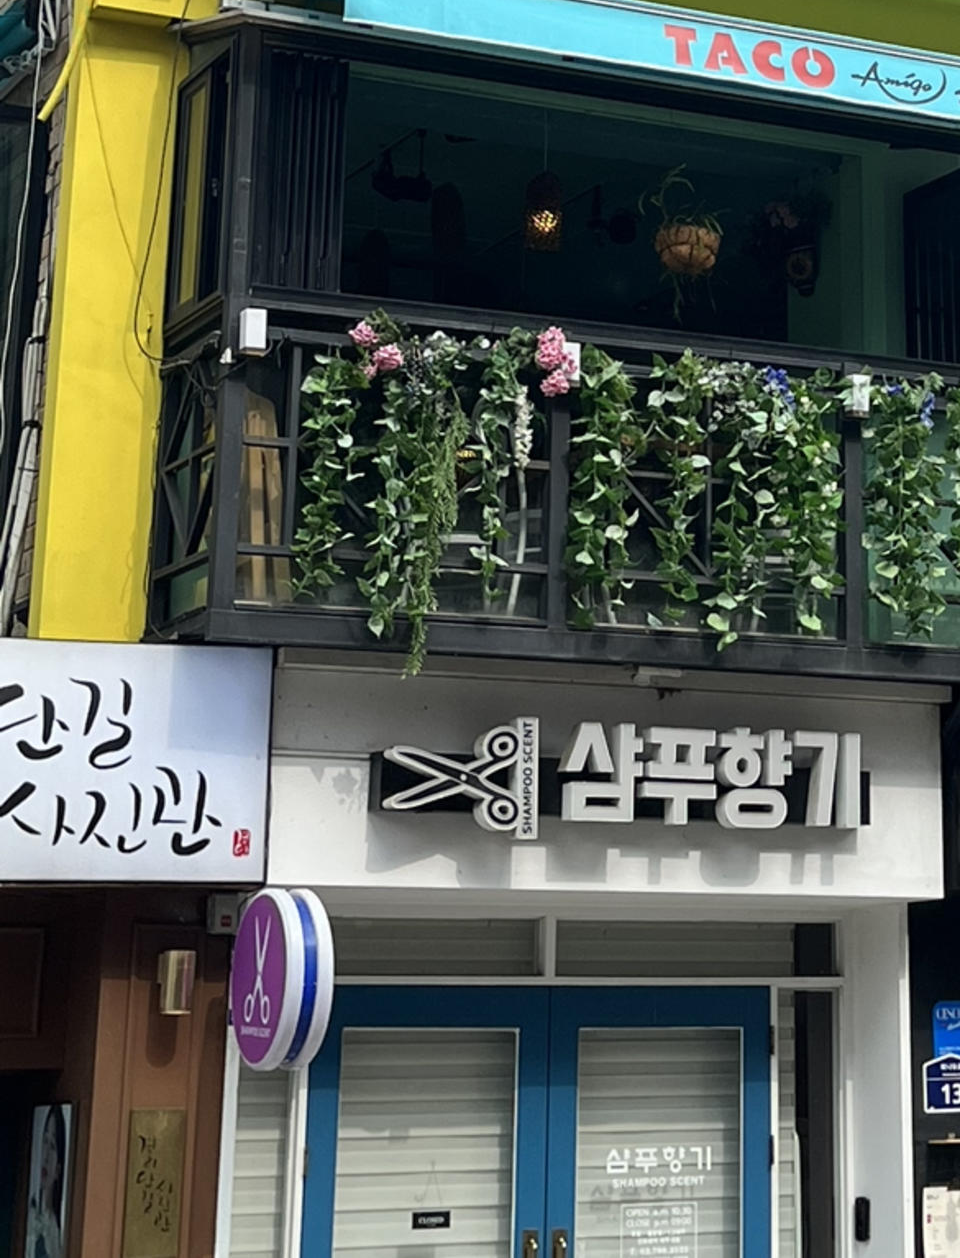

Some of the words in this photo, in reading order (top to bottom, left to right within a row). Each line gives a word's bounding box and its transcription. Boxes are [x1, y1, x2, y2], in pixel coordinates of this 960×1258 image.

[664, 24, 836, 88] TACO
[522, 721, 534, 763] SCENT
[522, 767, 533, 834] SHAMPOO
[557, 721, 862, 829] 샴푸향기
[0, 766, 222, 856] 사진관
[612, 1176, 667, 1190] SHAMPOO
[669, 1174, 705, 1188] SCENT
